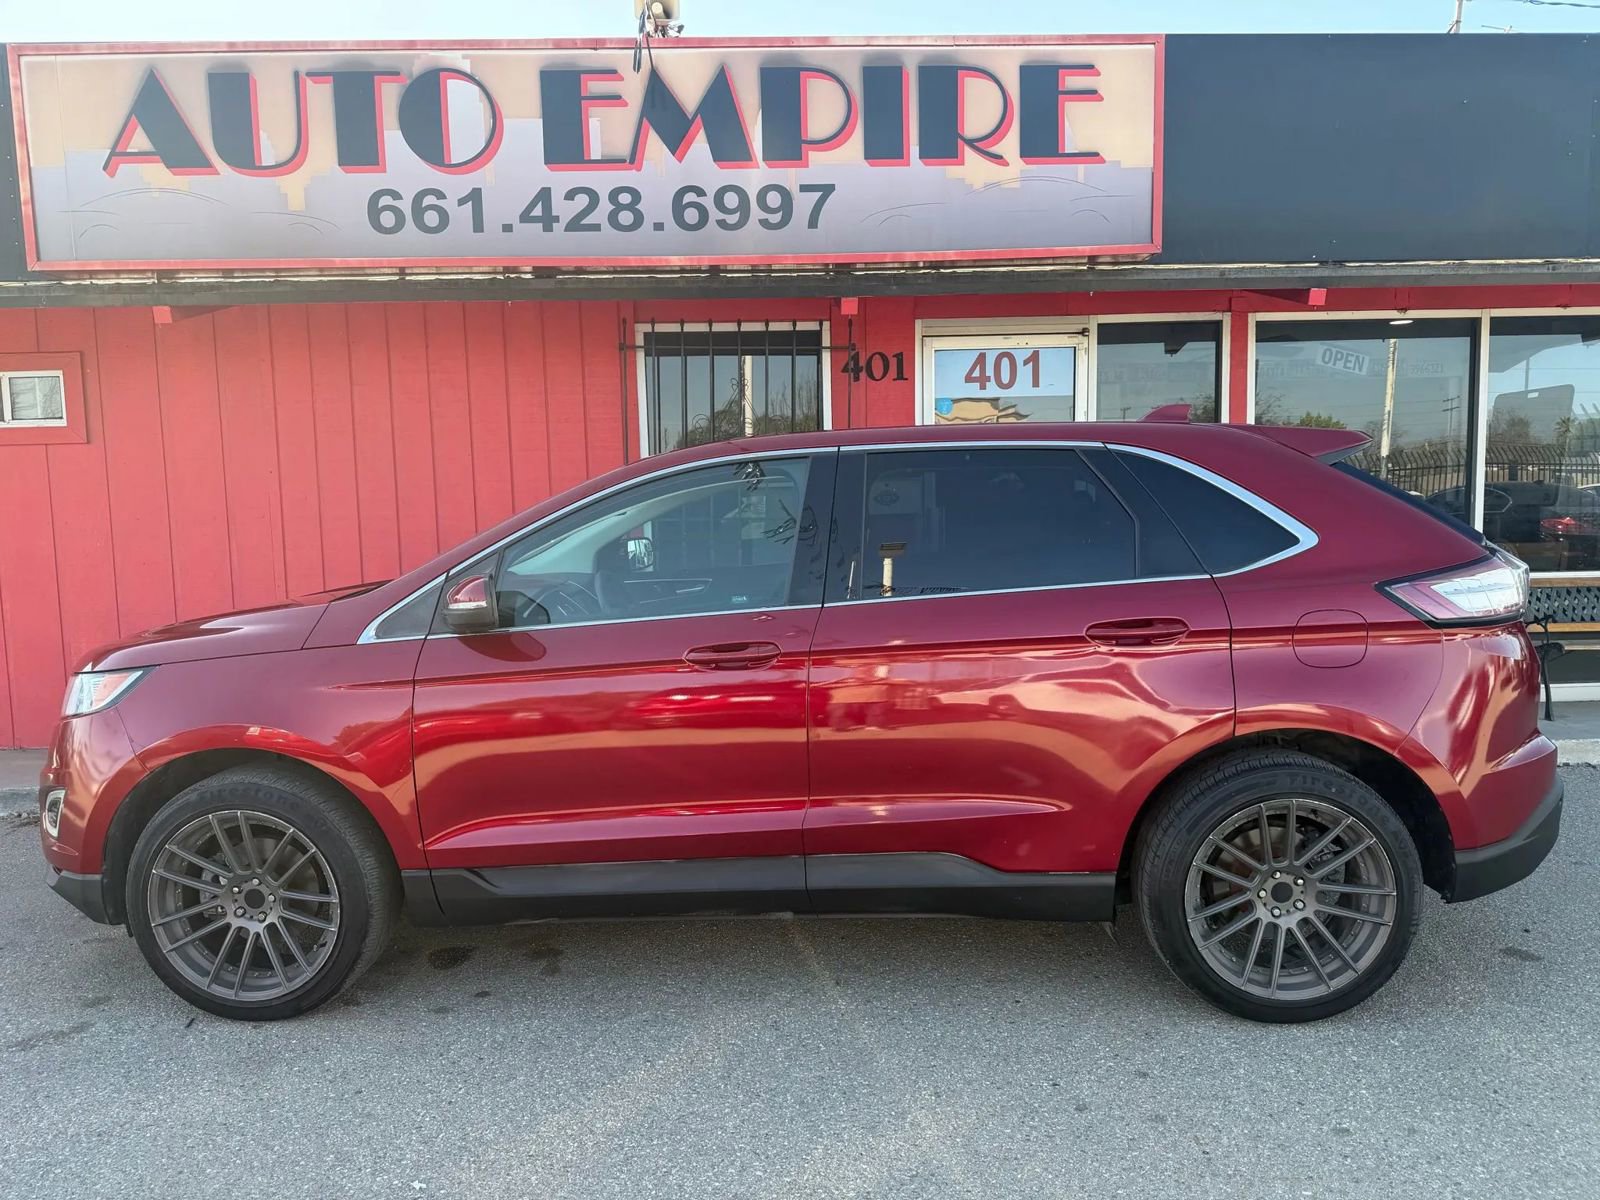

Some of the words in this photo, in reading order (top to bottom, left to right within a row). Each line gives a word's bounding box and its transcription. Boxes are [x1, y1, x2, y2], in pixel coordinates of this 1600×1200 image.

[103, 66, 504, 178] AUTO
[540, 64, 1106, 172] EMPIRE
[367, 183, 836, 235] 661.428.6997
[840, 351, 908, 383] 401
[964, 350, 1040, 390] 401
[1321, 347, 1365, 373] OPEN
